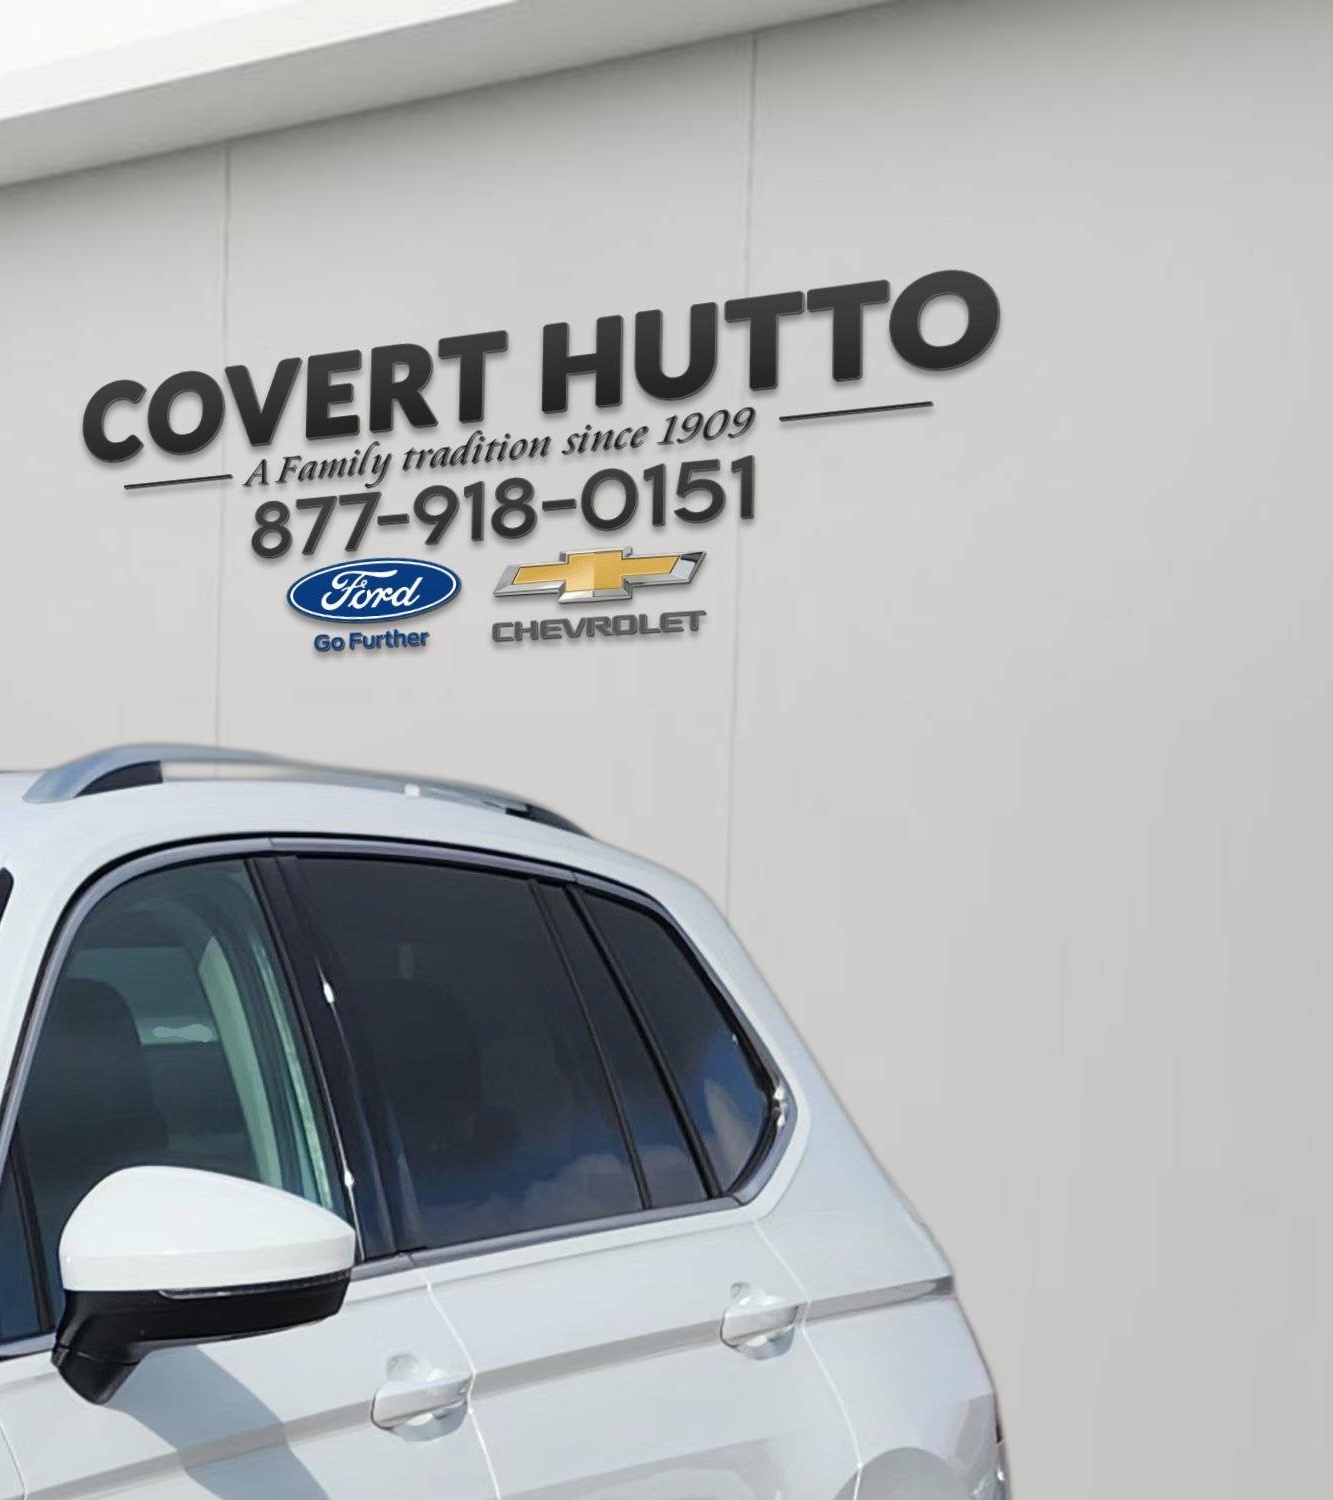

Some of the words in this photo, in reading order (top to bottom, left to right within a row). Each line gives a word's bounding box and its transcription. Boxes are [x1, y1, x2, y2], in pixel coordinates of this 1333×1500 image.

[81, 330, 509, 465] COVERT
[541, 268, 1002, 415] HUTTO
[242, 458, 269, 488] A
[275, 440, 393, 489] Family
[402, 429, 552, 472] tradition
[561, 424, 649, 456] since
[657, 406, 756, 446] 1909
[251, 454, 756, 560] 877-918-0151
[320, 570, 421, 610] Ford
[313, 633, 345, 653] Go
[348, 628, 430, 652] Further
[491, 609, 708, 644] CHEVROLET
